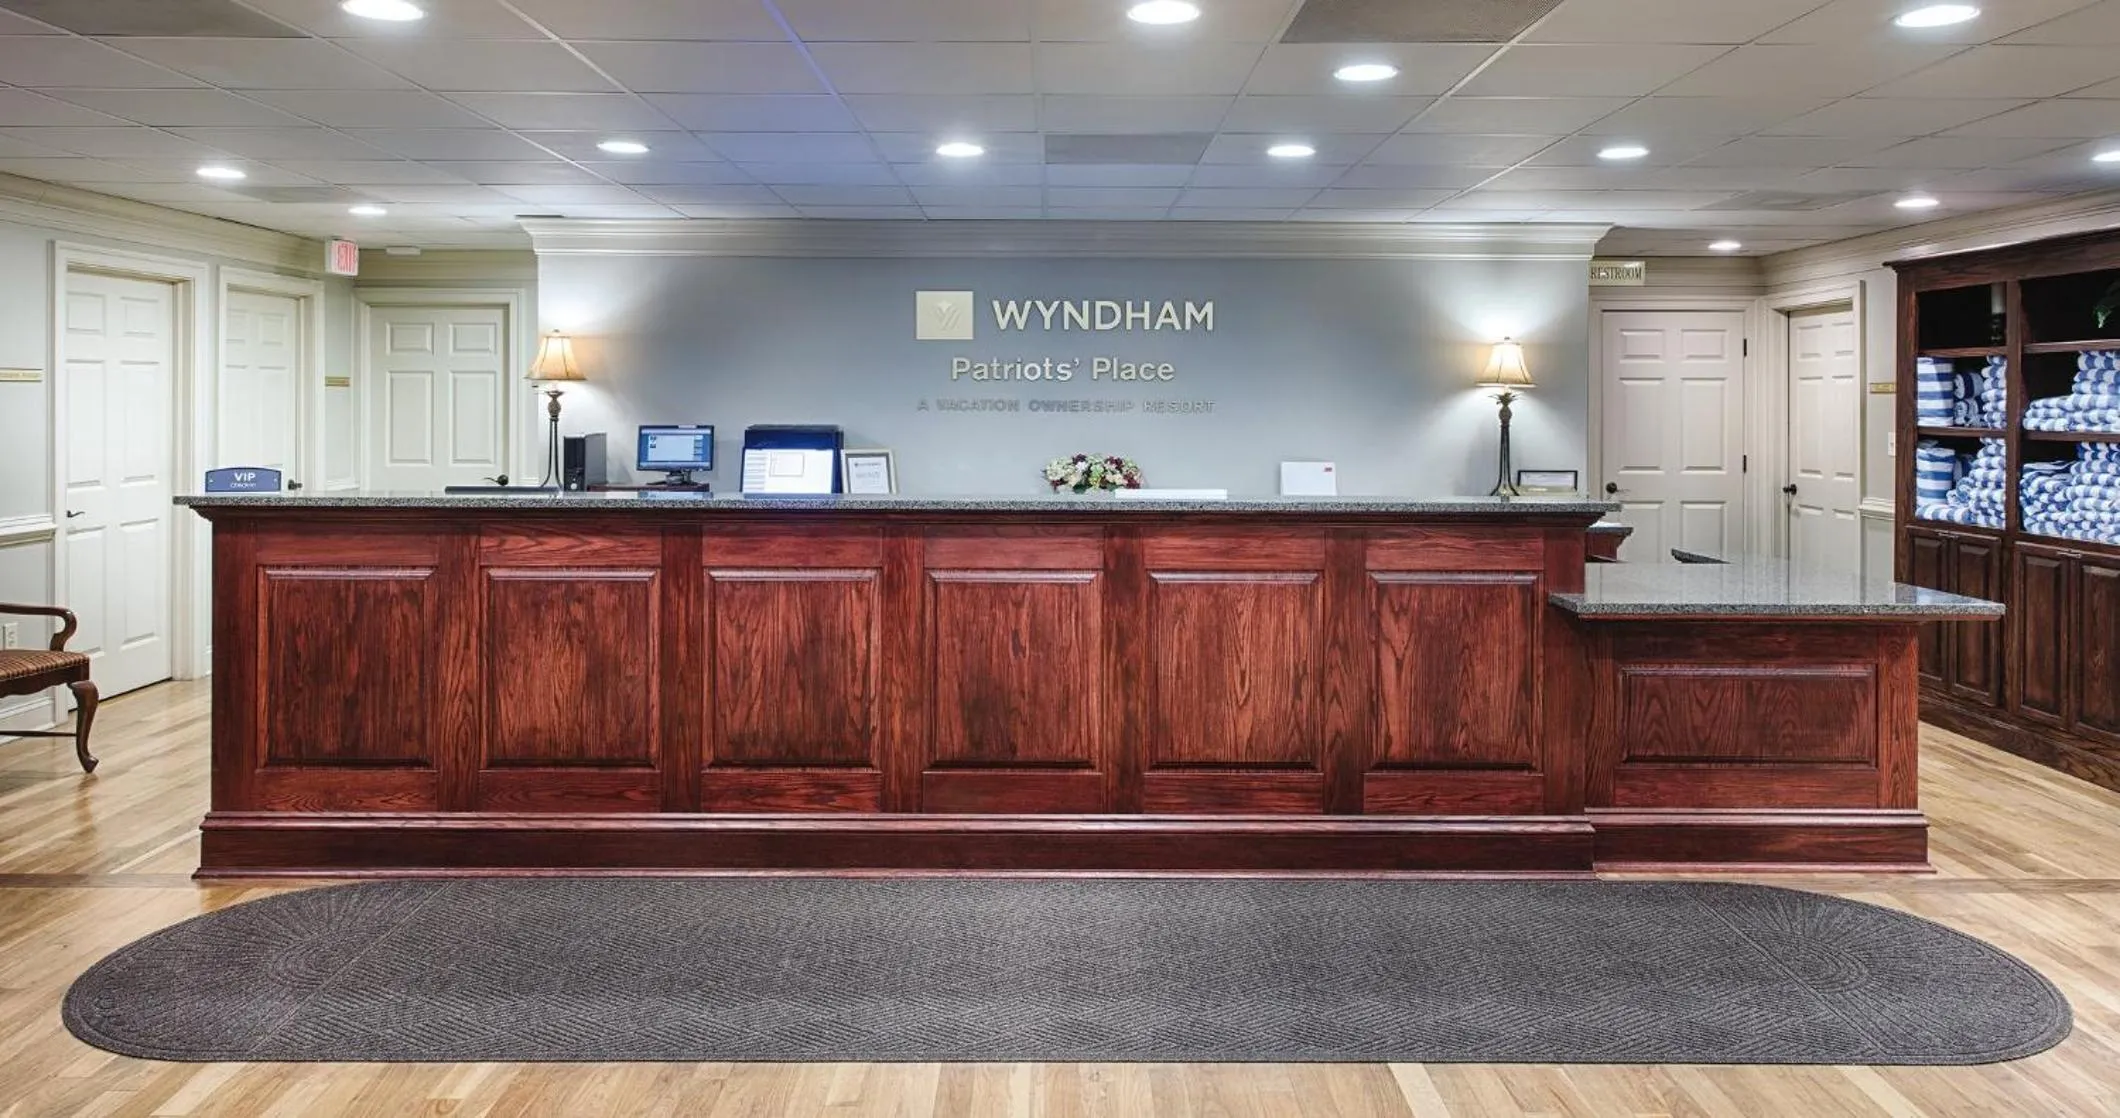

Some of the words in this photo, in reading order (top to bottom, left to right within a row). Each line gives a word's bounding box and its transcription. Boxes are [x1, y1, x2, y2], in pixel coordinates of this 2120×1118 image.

[1590, 266, 1642, 280] RESTROOM
[992, 299, 1214, 330] WYNDHAM
[1092, 357, 1175, 382] Place
[917, 400, 929, 411] A
[937, 399, 1020, 412] VACATION
[1028, 399, 1134, 413] OWNERSHIP
[1143, 400, 1216, 413] RESORT
[233, 472, 256, 481] VIP
